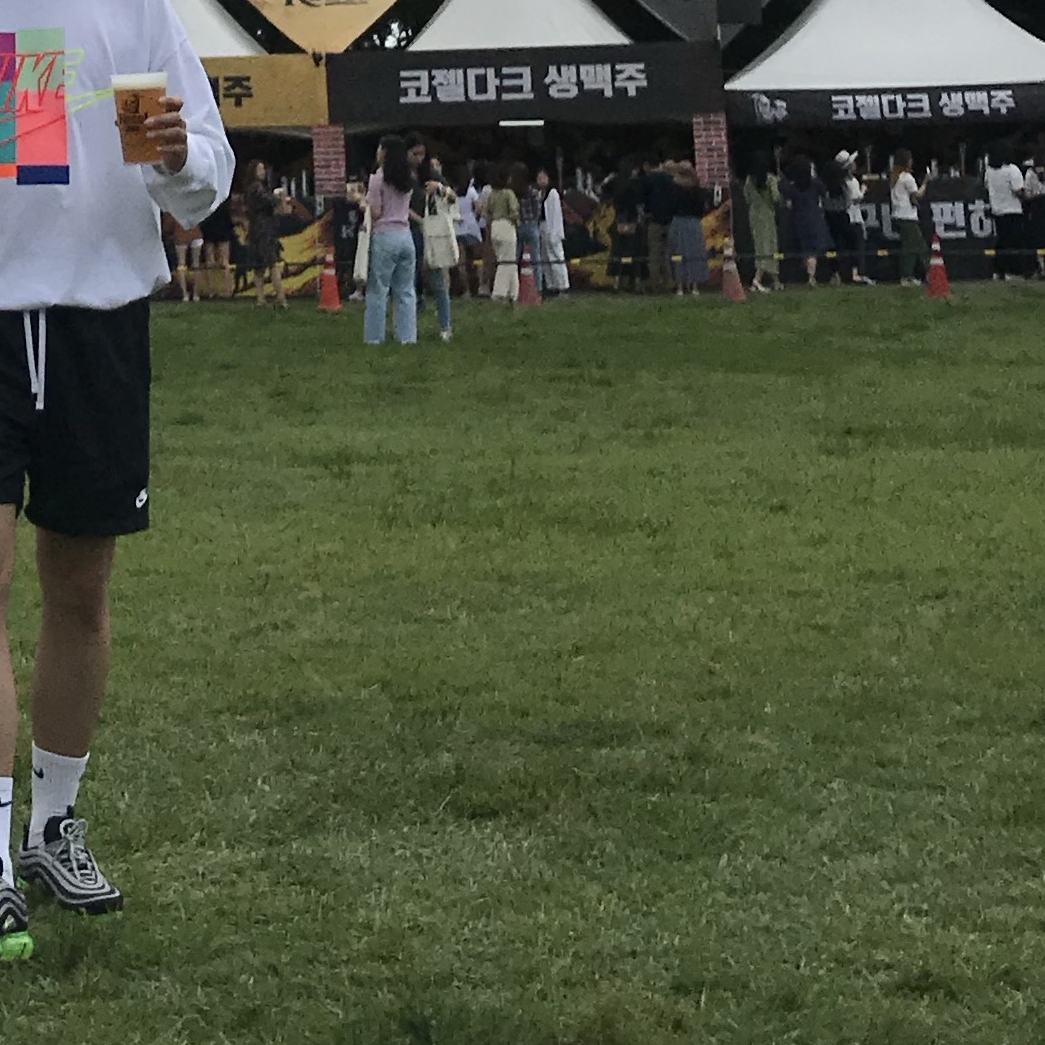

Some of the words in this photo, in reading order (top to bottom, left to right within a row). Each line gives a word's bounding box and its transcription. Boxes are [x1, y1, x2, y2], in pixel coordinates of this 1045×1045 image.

[208, 75, 254, 108] 주
[398, 66, 536, 105] 코젤다크
[543, 62, 649, 100] 생맥주
[830, 91, 934, 122] 코젤다크
[938, 88, 1018, 117] 생맥주
